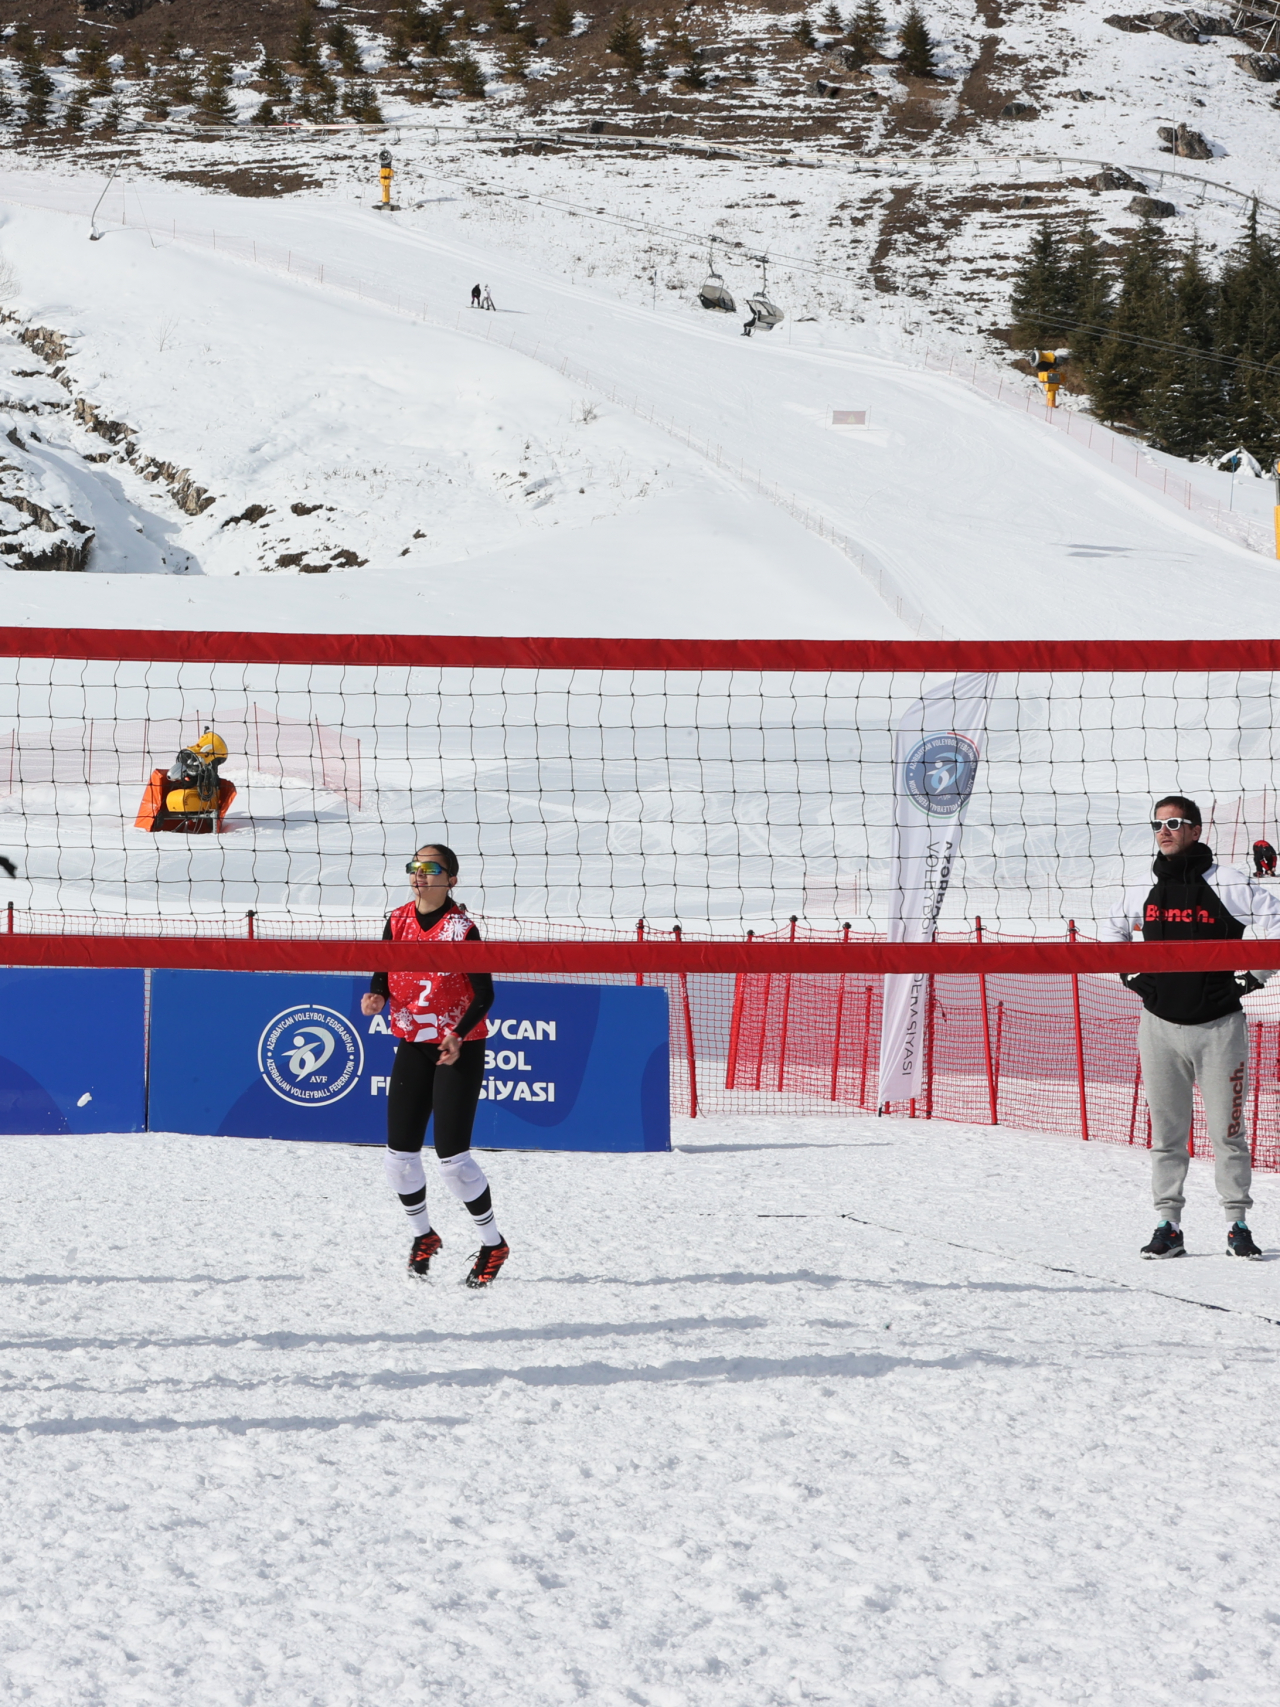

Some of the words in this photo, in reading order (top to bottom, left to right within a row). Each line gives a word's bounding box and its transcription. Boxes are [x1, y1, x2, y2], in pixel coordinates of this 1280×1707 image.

[417, 979, 432, 1007] 2
[266, 1016, 295, 1051] AZƏRBAYCAN
[293, 1011, 326, 1023] VOLEYBOL
[266, 1058, 291, 1092] AZERBAIJAN
[290, 1086, 331, 1099] VOLLEYBALL
[328, 1060, 355, 1093] FEDERATION
[309, 1075, 328, 1083] AVF
[1227, 1061, 1245, 1138] Bench.
